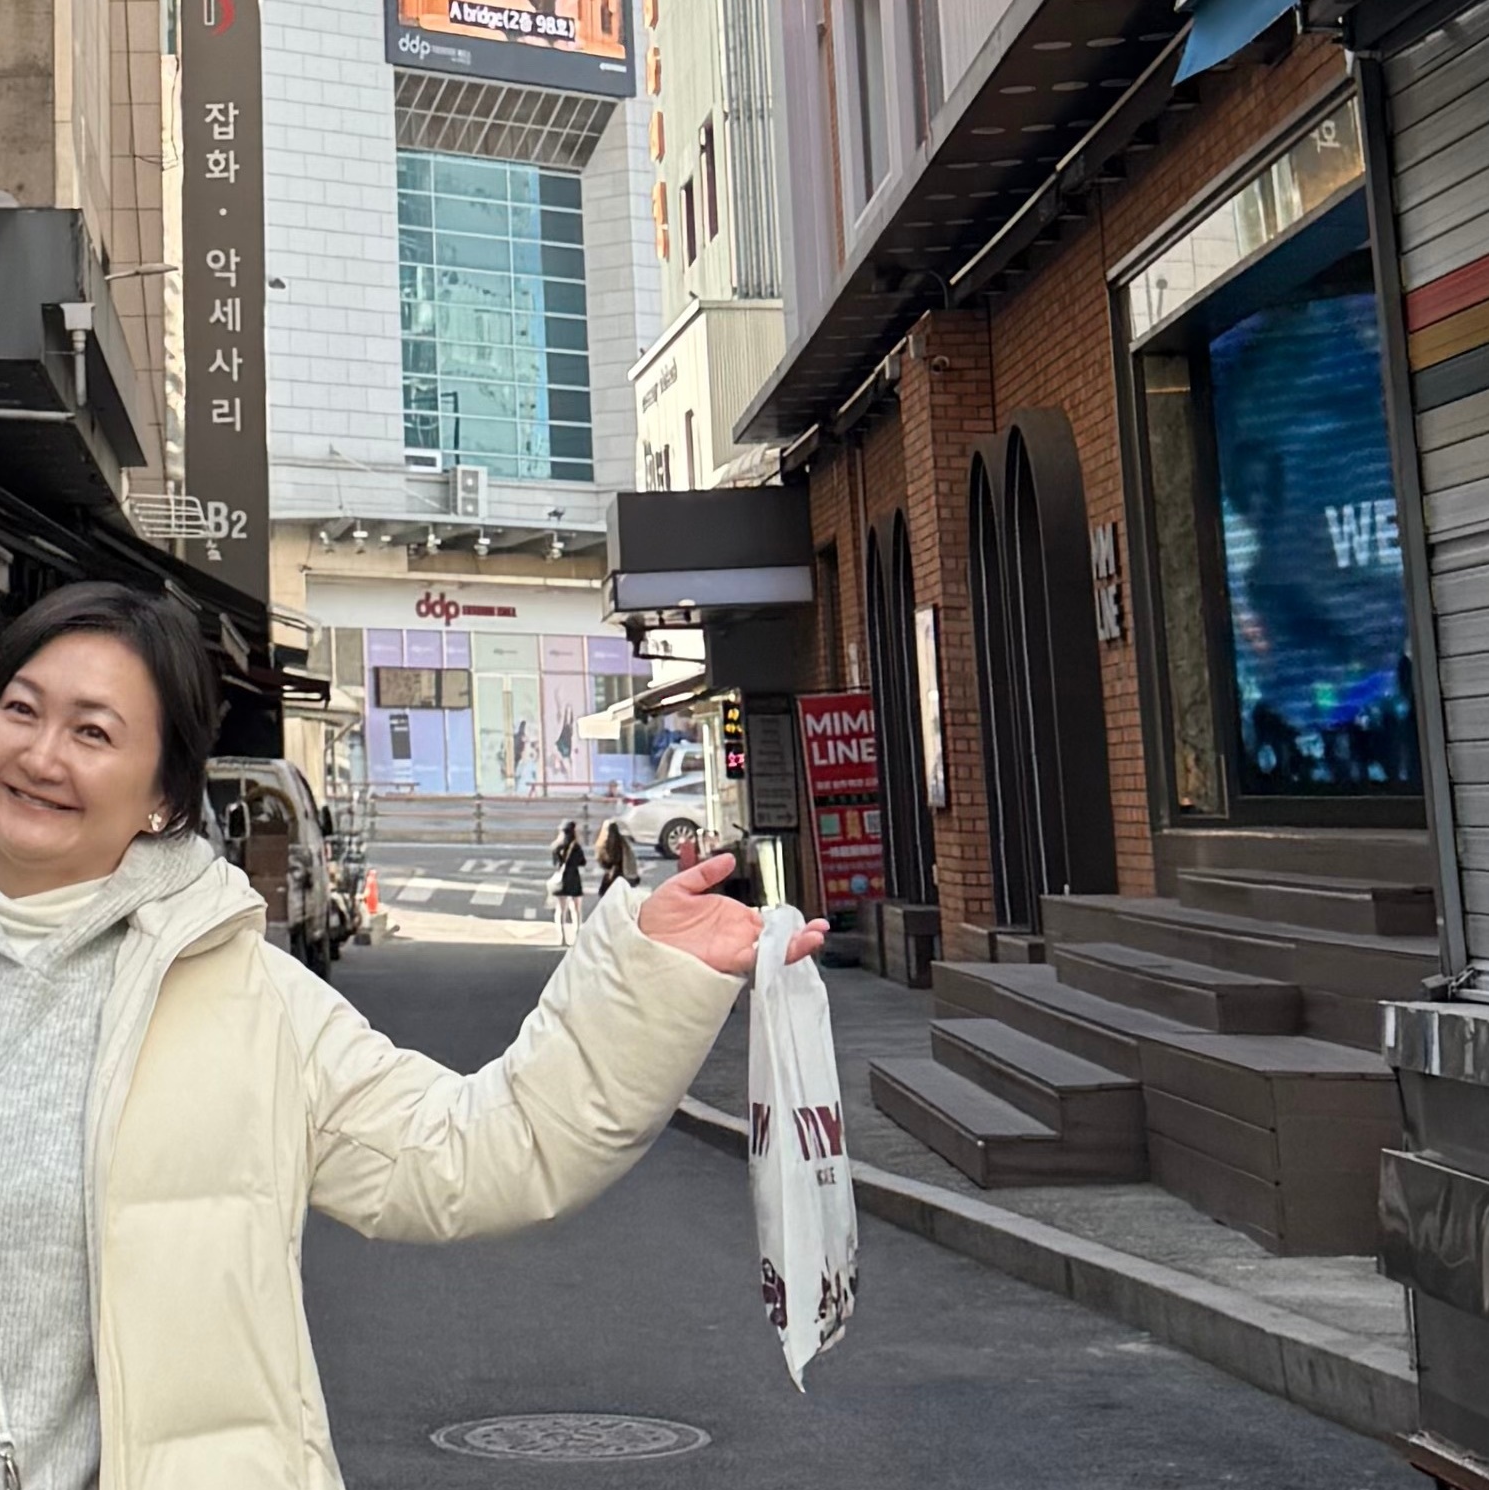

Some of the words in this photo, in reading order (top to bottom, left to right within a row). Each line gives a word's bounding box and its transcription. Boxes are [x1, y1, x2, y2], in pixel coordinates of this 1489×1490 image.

[398, 33, 431, 60] ddp
[204, 102, 240, 184] 잡화
[206, 248, 243, 432] 악세사리
[207, 501, 248, 539] B2
[415, 592, 460, 627] ddp
[805, 709, 875, 738] MIMI
[812, 737, 878, 766] LINE
